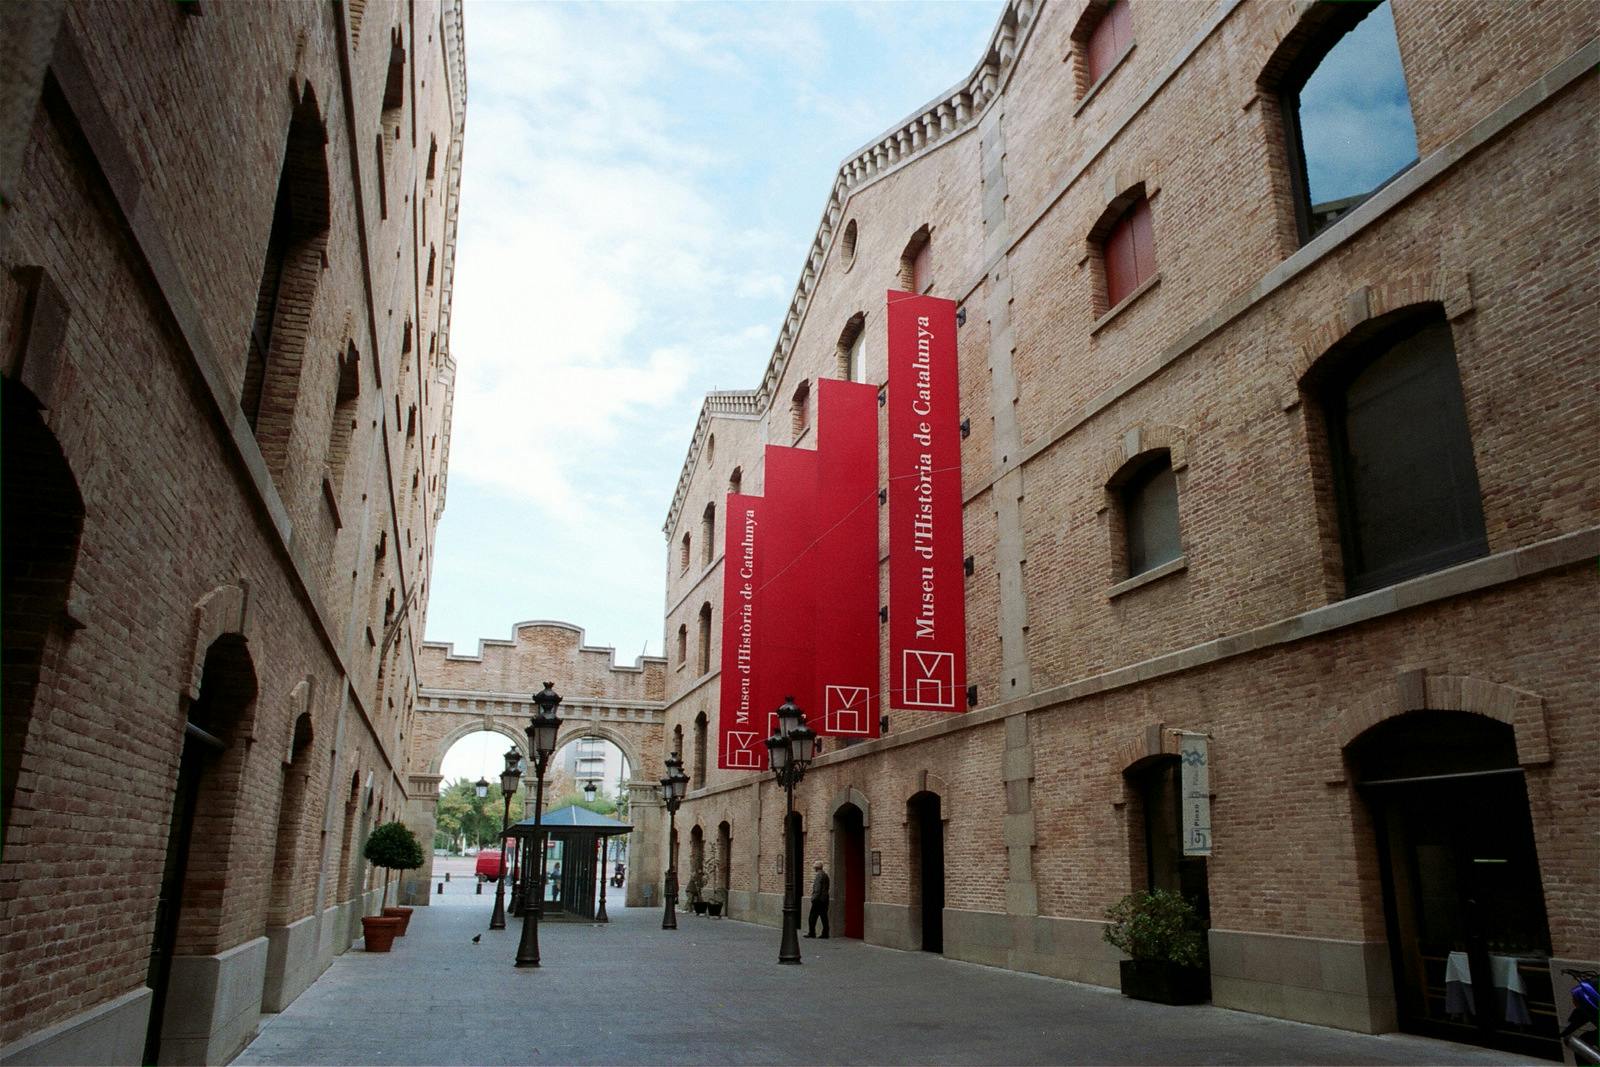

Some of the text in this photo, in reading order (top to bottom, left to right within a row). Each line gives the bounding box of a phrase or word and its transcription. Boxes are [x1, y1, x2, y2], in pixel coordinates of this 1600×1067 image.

[911, 315, 935, 640] Museu d'Història de Catalunya
[735, 509, 758, 725] Museu d'Història de Catalunya
